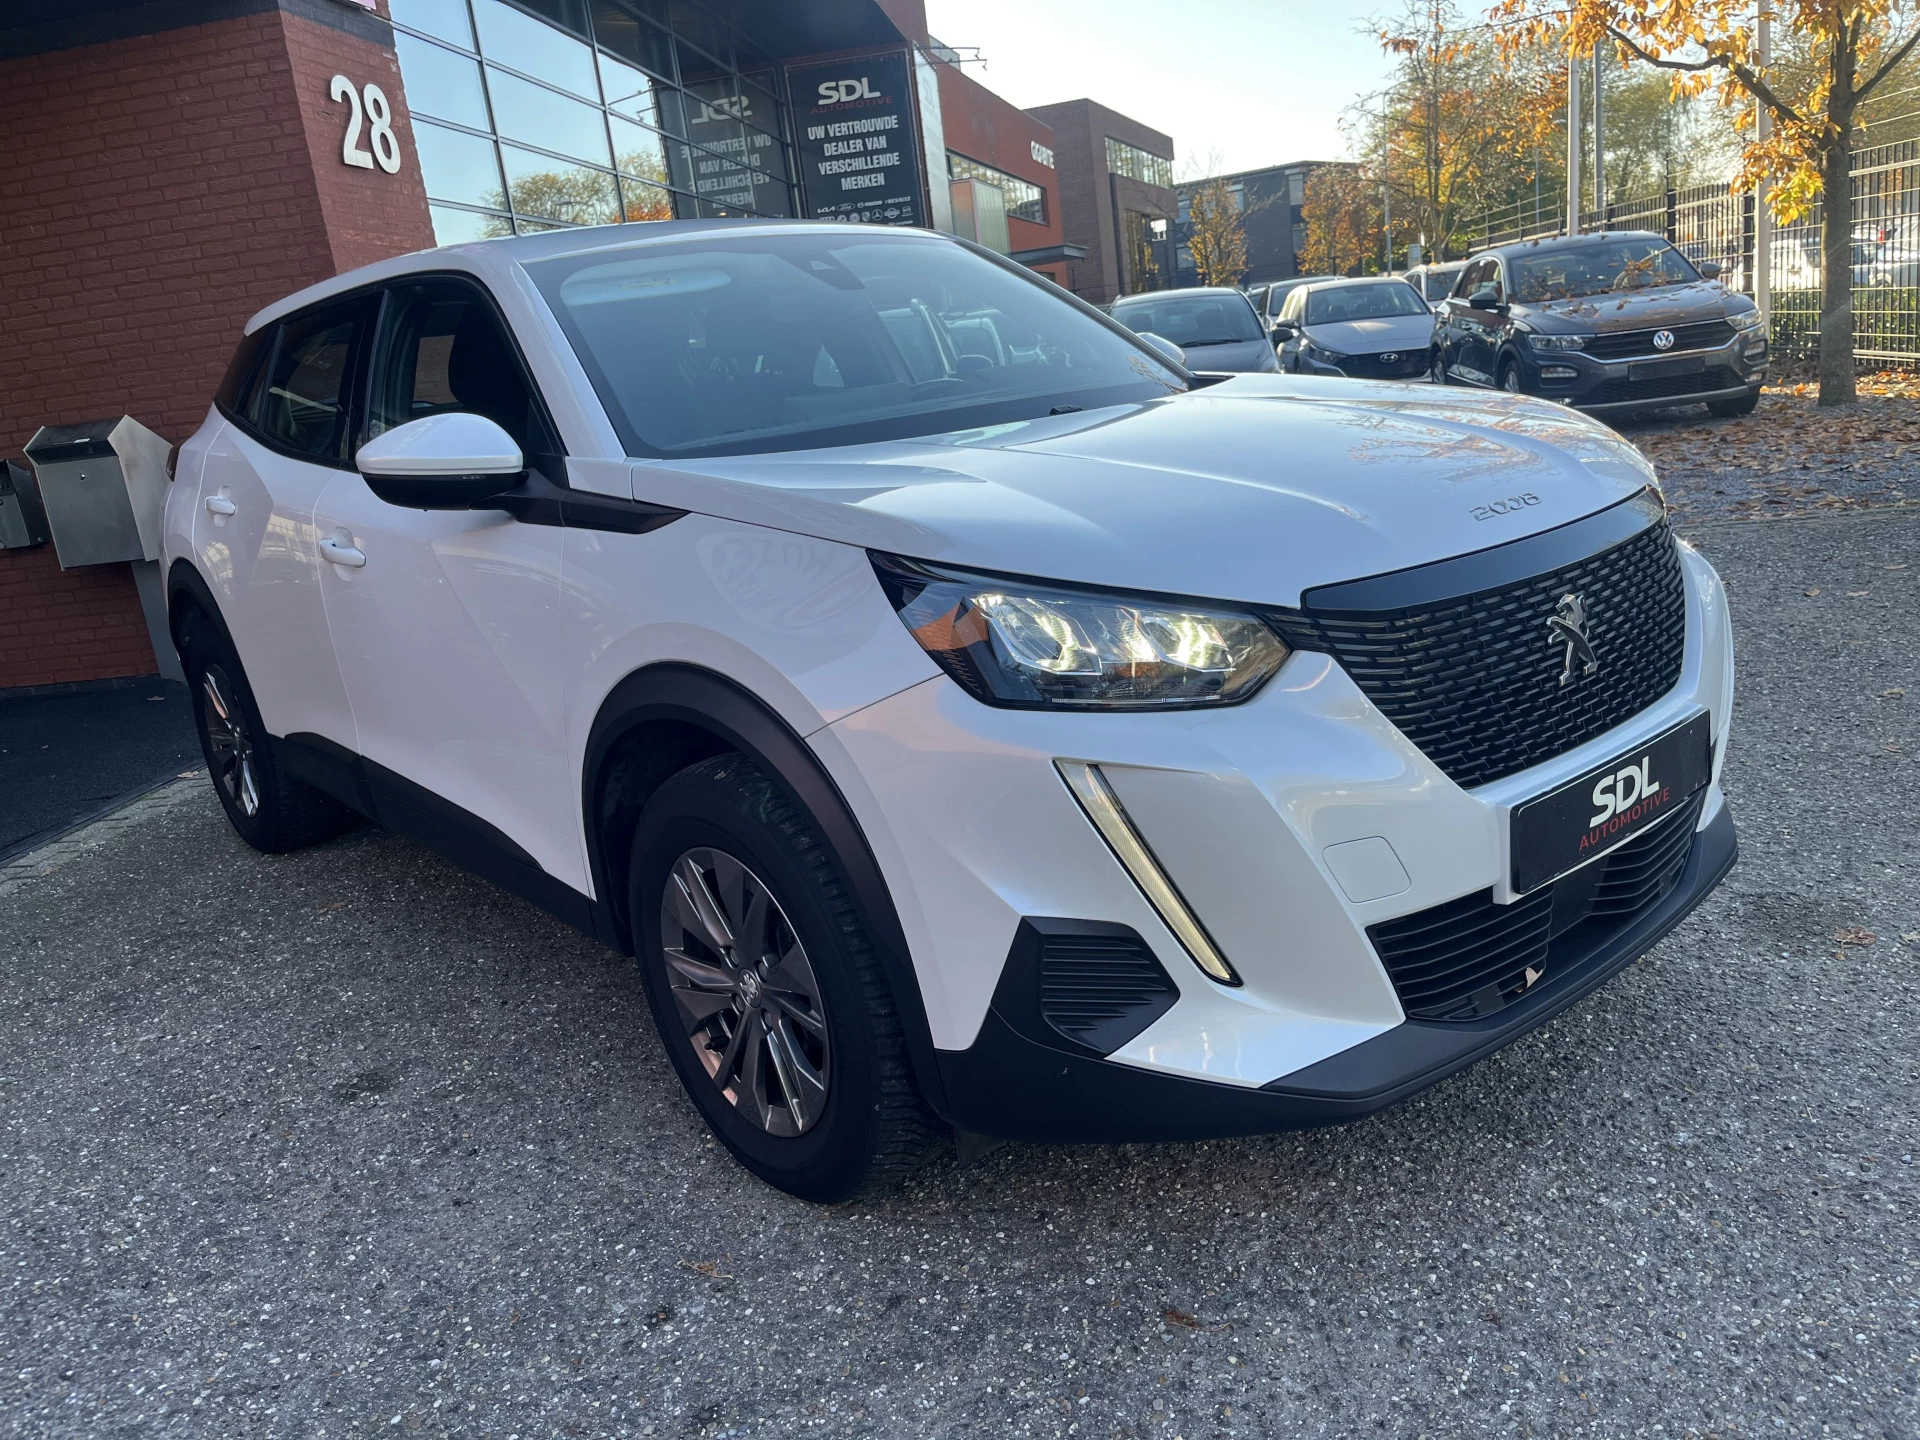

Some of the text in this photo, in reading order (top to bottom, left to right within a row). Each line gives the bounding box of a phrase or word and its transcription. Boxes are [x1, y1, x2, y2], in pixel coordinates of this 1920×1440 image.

[818, 77, 881, 105] SDL
[811, 96, 893, 114] AUTOMOTIVE
[330, 74, 401, 174] 28
[808, 115, 899, 140] UW VERTROUWDE
[824, 135, 887, 156] DEALER VAN
[818, 152, 900, 175] VERSCHILLENDE
[841, 172, 885, 191] MERKEN
[1589, 756, 1660, 828] SDL
[1578, 787, 1670, 852] AUTOMOTIVE
